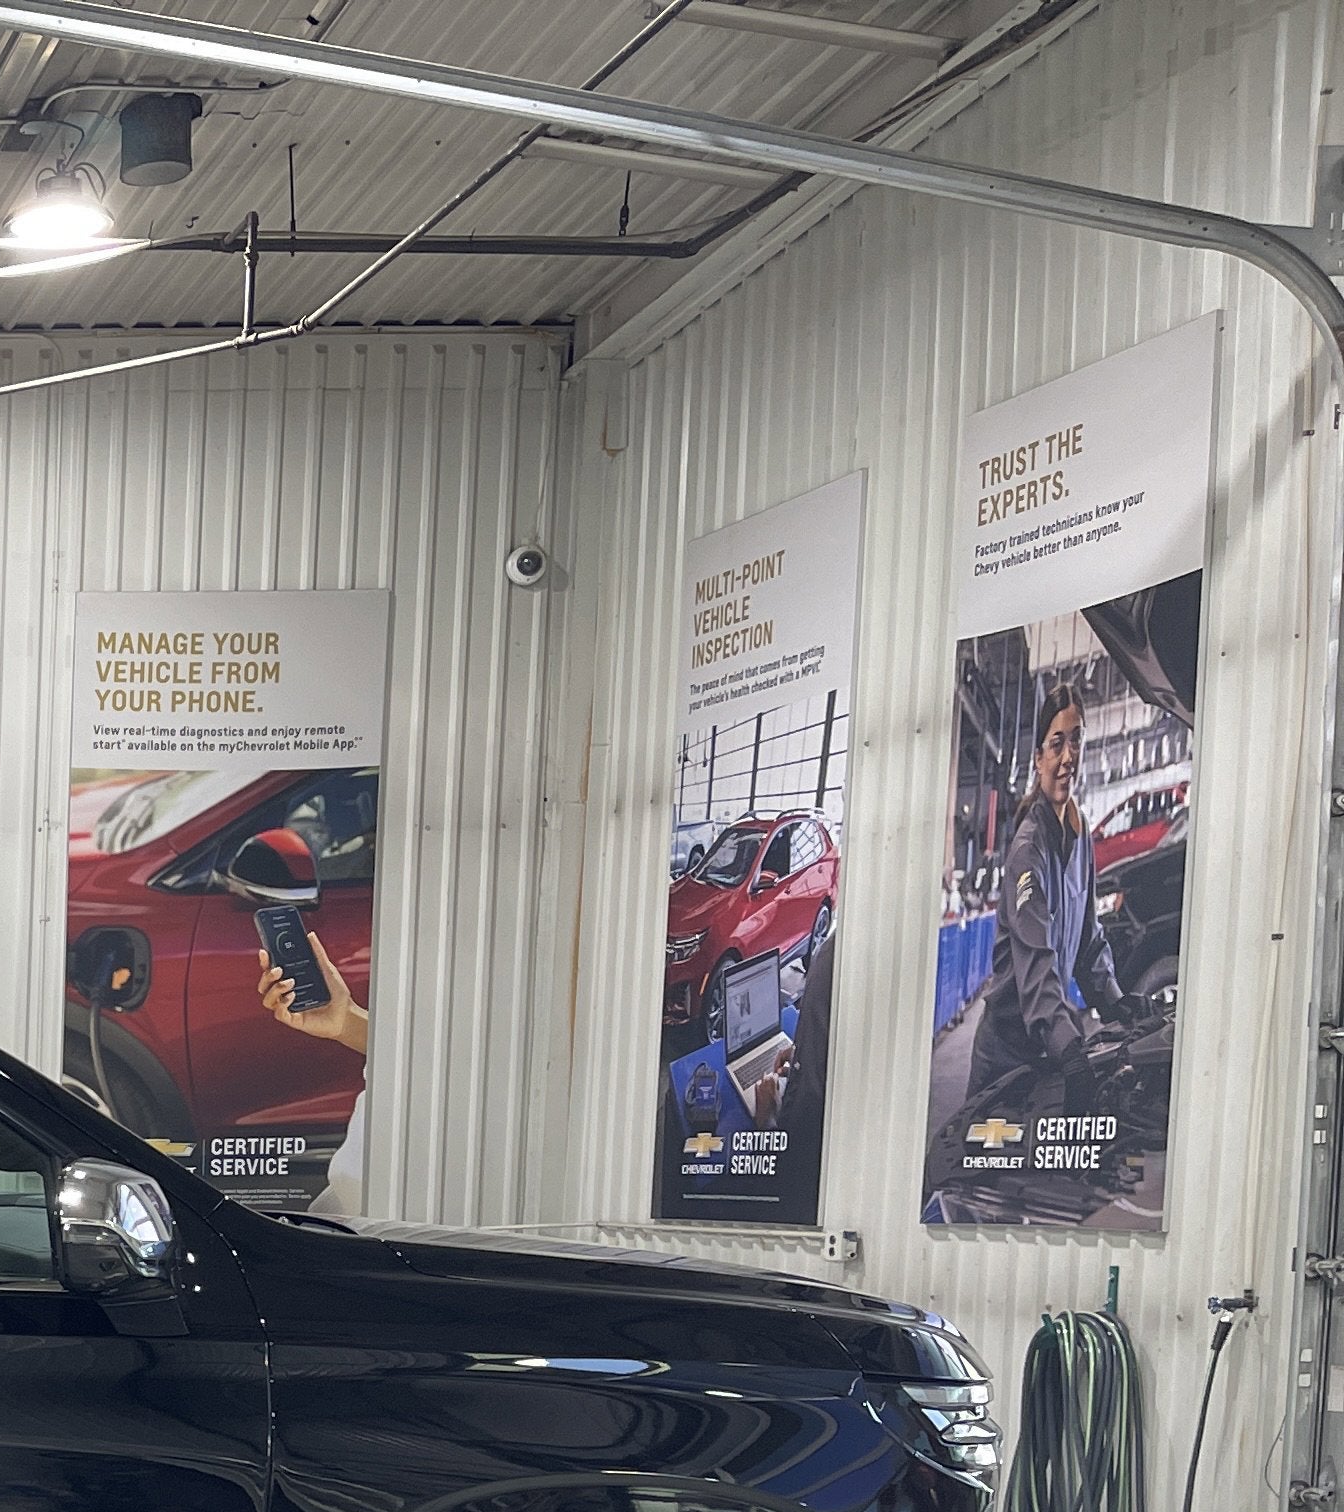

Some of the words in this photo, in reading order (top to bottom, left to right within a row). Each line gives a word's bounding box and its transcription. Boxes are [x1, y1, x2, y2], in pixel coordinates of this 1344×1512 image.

[979, 440, 1040, 489] TRUST
[1045, 423, 1084, 464] THE
[977, 470, 1070, 527] EXPERTS.
[975, 540, 1007, 558] Factory
[1009, 525, 1040, 547] trained
[1042, 510, 1093, 537] technicians
[1095, 501, 1120, 519] know
[1122, 491, 1145, 514] your
[974, 562, 999, 576] Chevy
[1001, 549, 1031, 569] vehicle
[1033, 540, 1062, 560] better
[1063, 531, 1084, 549] than
[1085, 520, 1122, 543] anyone.
[695, 549, 785, 606] MULTI-POINT
[694, 595, 751, 637] VEHICLE
[97, 631, 205, 655] MANAGE
[213, 632, 280, 655] YOUR
[691, 619, 773, 670] INSPECTION
[95, 660, 203, 684] VEHICLE
[211, 661, 280, 684] FROM
[690, 684, 701, 695] The
[701, 678, 719, 694] peace
[720, 674, 728, 686] of
[728, 669, 744, 683] mind
[745, 665, 759, 678] that
[759, 659, 781, 674] comes
[782, 654, 798, 667] from
[799, 645, 825, 665] getting
[94, 689, 161, 713] YOUR
[170, 690, 263, 713] PHONE.
[688, 700, 702, 715] your
[730, 684, 750, 698] health
[751, 674, 778, 694] checked
[779, 670, 794, 684] with
[795, 671, 799, 680] a
[93, 724, 120, 736] View
[124, 725, 176, 737] real-time
[180, 725, 244, 740] diagnostics
[247, 726, 268, 737] and
[271, 725, 301, 740] enjoy
[304, 724, 345, 735] remote
[127, 739, 177, 751] available
[180, 741, 193, 751] on
[197, 739, 215, 752] the
[218, 739, 290, 754] myChevrolet
[293, 738, 329, 750] Mobile
[1036, 1116, 1117, 1141] CERTIFIED
[210, 1137, 306, 1155] CERTIFIED
[732, 1131, 788, 1152] CERTIFIED
[210, 1158, 289, 1176] SERVICE
[681, 1164, 725, 1174] CHEVROLET
[730, 1155, 777, 1175] SERVICE
[963, 1156, 1025, 1169] CHEVROLET
[1034, 1145, 1101, 1169] SERVICE
